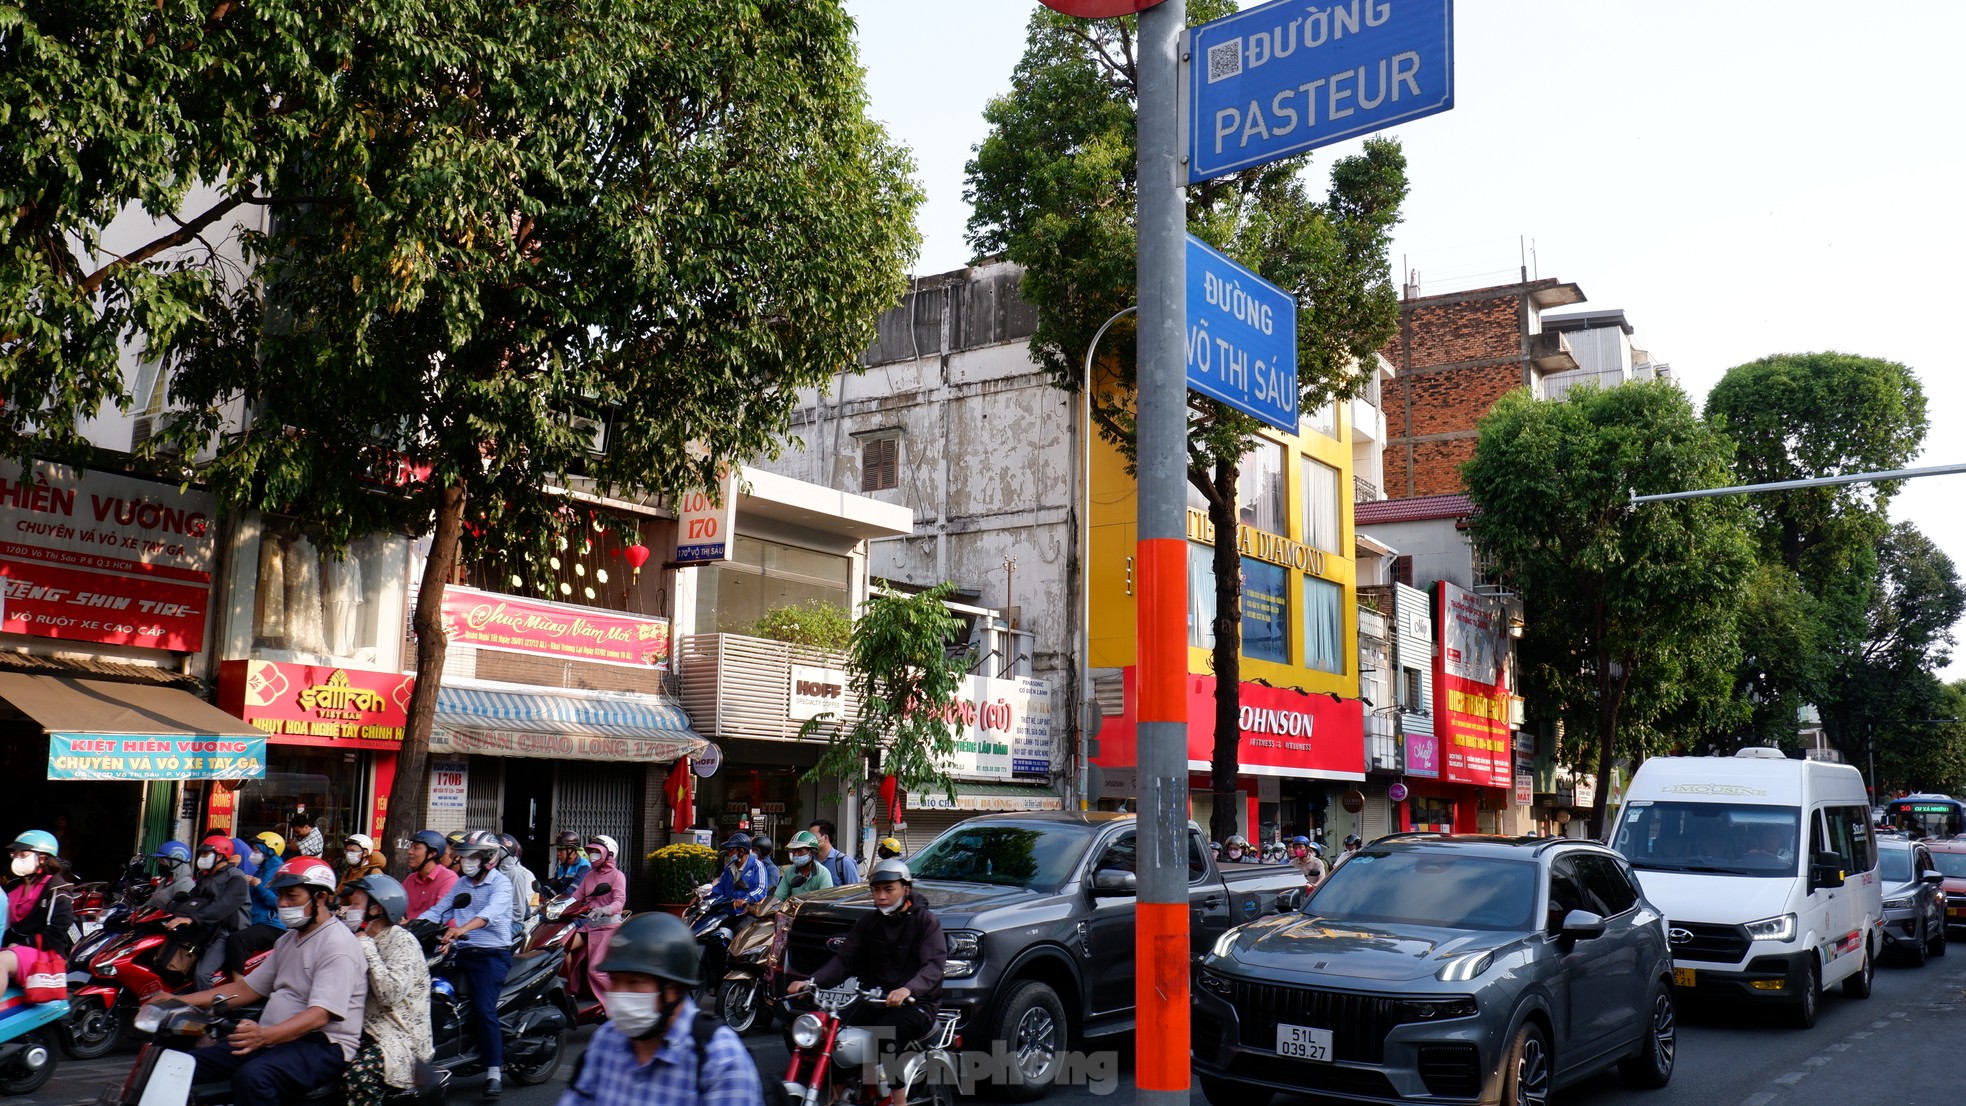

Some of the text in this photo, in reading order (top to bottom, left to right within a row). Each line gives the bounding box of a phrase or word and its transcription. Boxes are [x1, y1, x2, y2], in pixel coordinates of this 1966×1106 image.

[1245, 0, 1391, 69] ĐƯỜNG
[1215, 50, 1422, 155] PASTEUR
[1204, 270, 1273, 336] ĐƯỜNG
[1186, 318, 1293, 413] VÕ THỊ SÁU
[16, 520, 76, 540] CHUYÊN
[120, 537, 139, 550] XE
[688, 517, 718, 539] 170
[1257, 531, 1326, 575] DIAMOND
[4, 579, 70, 602] HENG
[80, 620, 100, 630] XE
[103, 622, 134, 634] CAO
[796, 680, 842, 699] HOFF
[796, 699, 840, 709] SPECIALTY COFFEE
[286, 720, 307, 736] HOA
[1239, 705, 1314, 738] OHNSON
[71, 738, 116, 754] KIỆT
[633, 742, 681, 760] 170B
[56, 755, 123, 770] CHUYÊN
[184, 758, 203, 769] XE
[208, 758, 233, 770] TAY
[237, 758, 259, 770] GA
[437, 772, 462, 786] 170B
[1661, 784, 1768, 797] LIMOUSINE
[1292, 1028, 1316, 1043] 51L
[1282, 1041, 1326, 1060] 039.27
